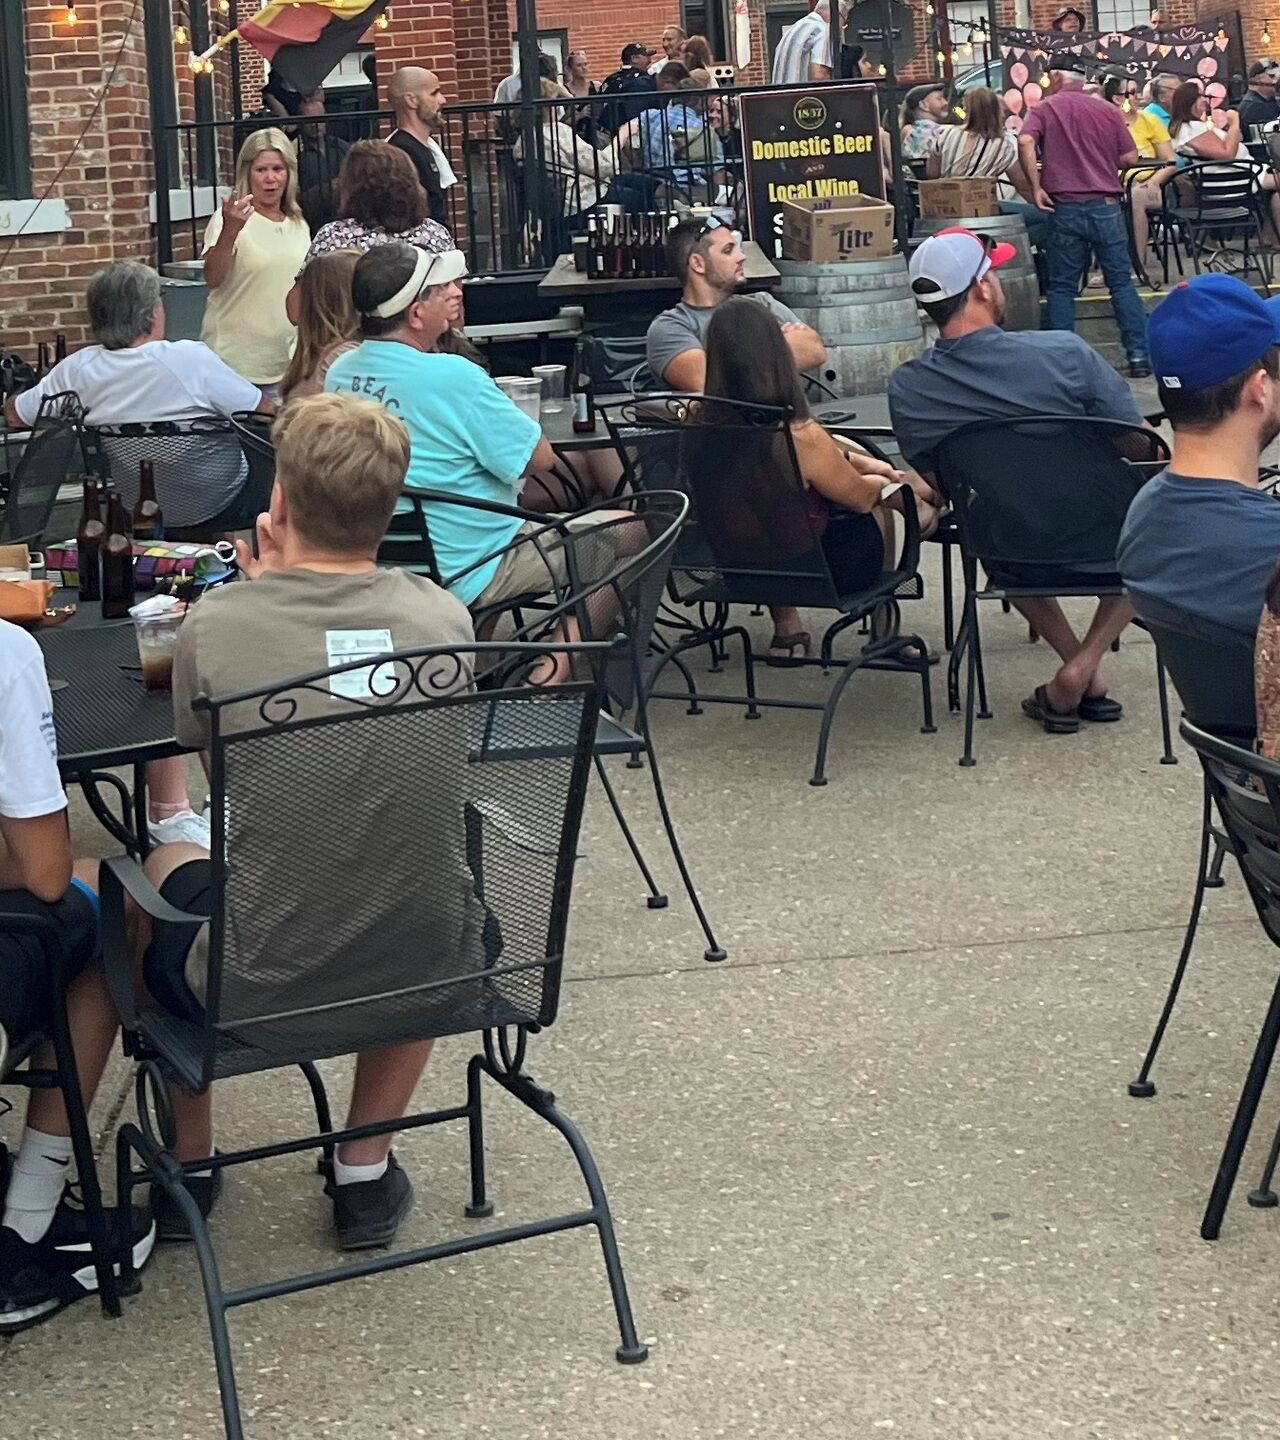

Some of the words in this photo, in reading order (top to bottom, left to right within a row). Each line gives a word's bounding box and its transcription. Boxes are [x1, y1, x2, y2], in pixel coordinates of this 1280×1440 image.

[752, 135, 831, 160] Domestic
[833, 134, 873, 155] Beer
[768, 180, 813, 203] Local
[815, 177, 859, 198] Wine
[831, 228, 874, 255] Lite
